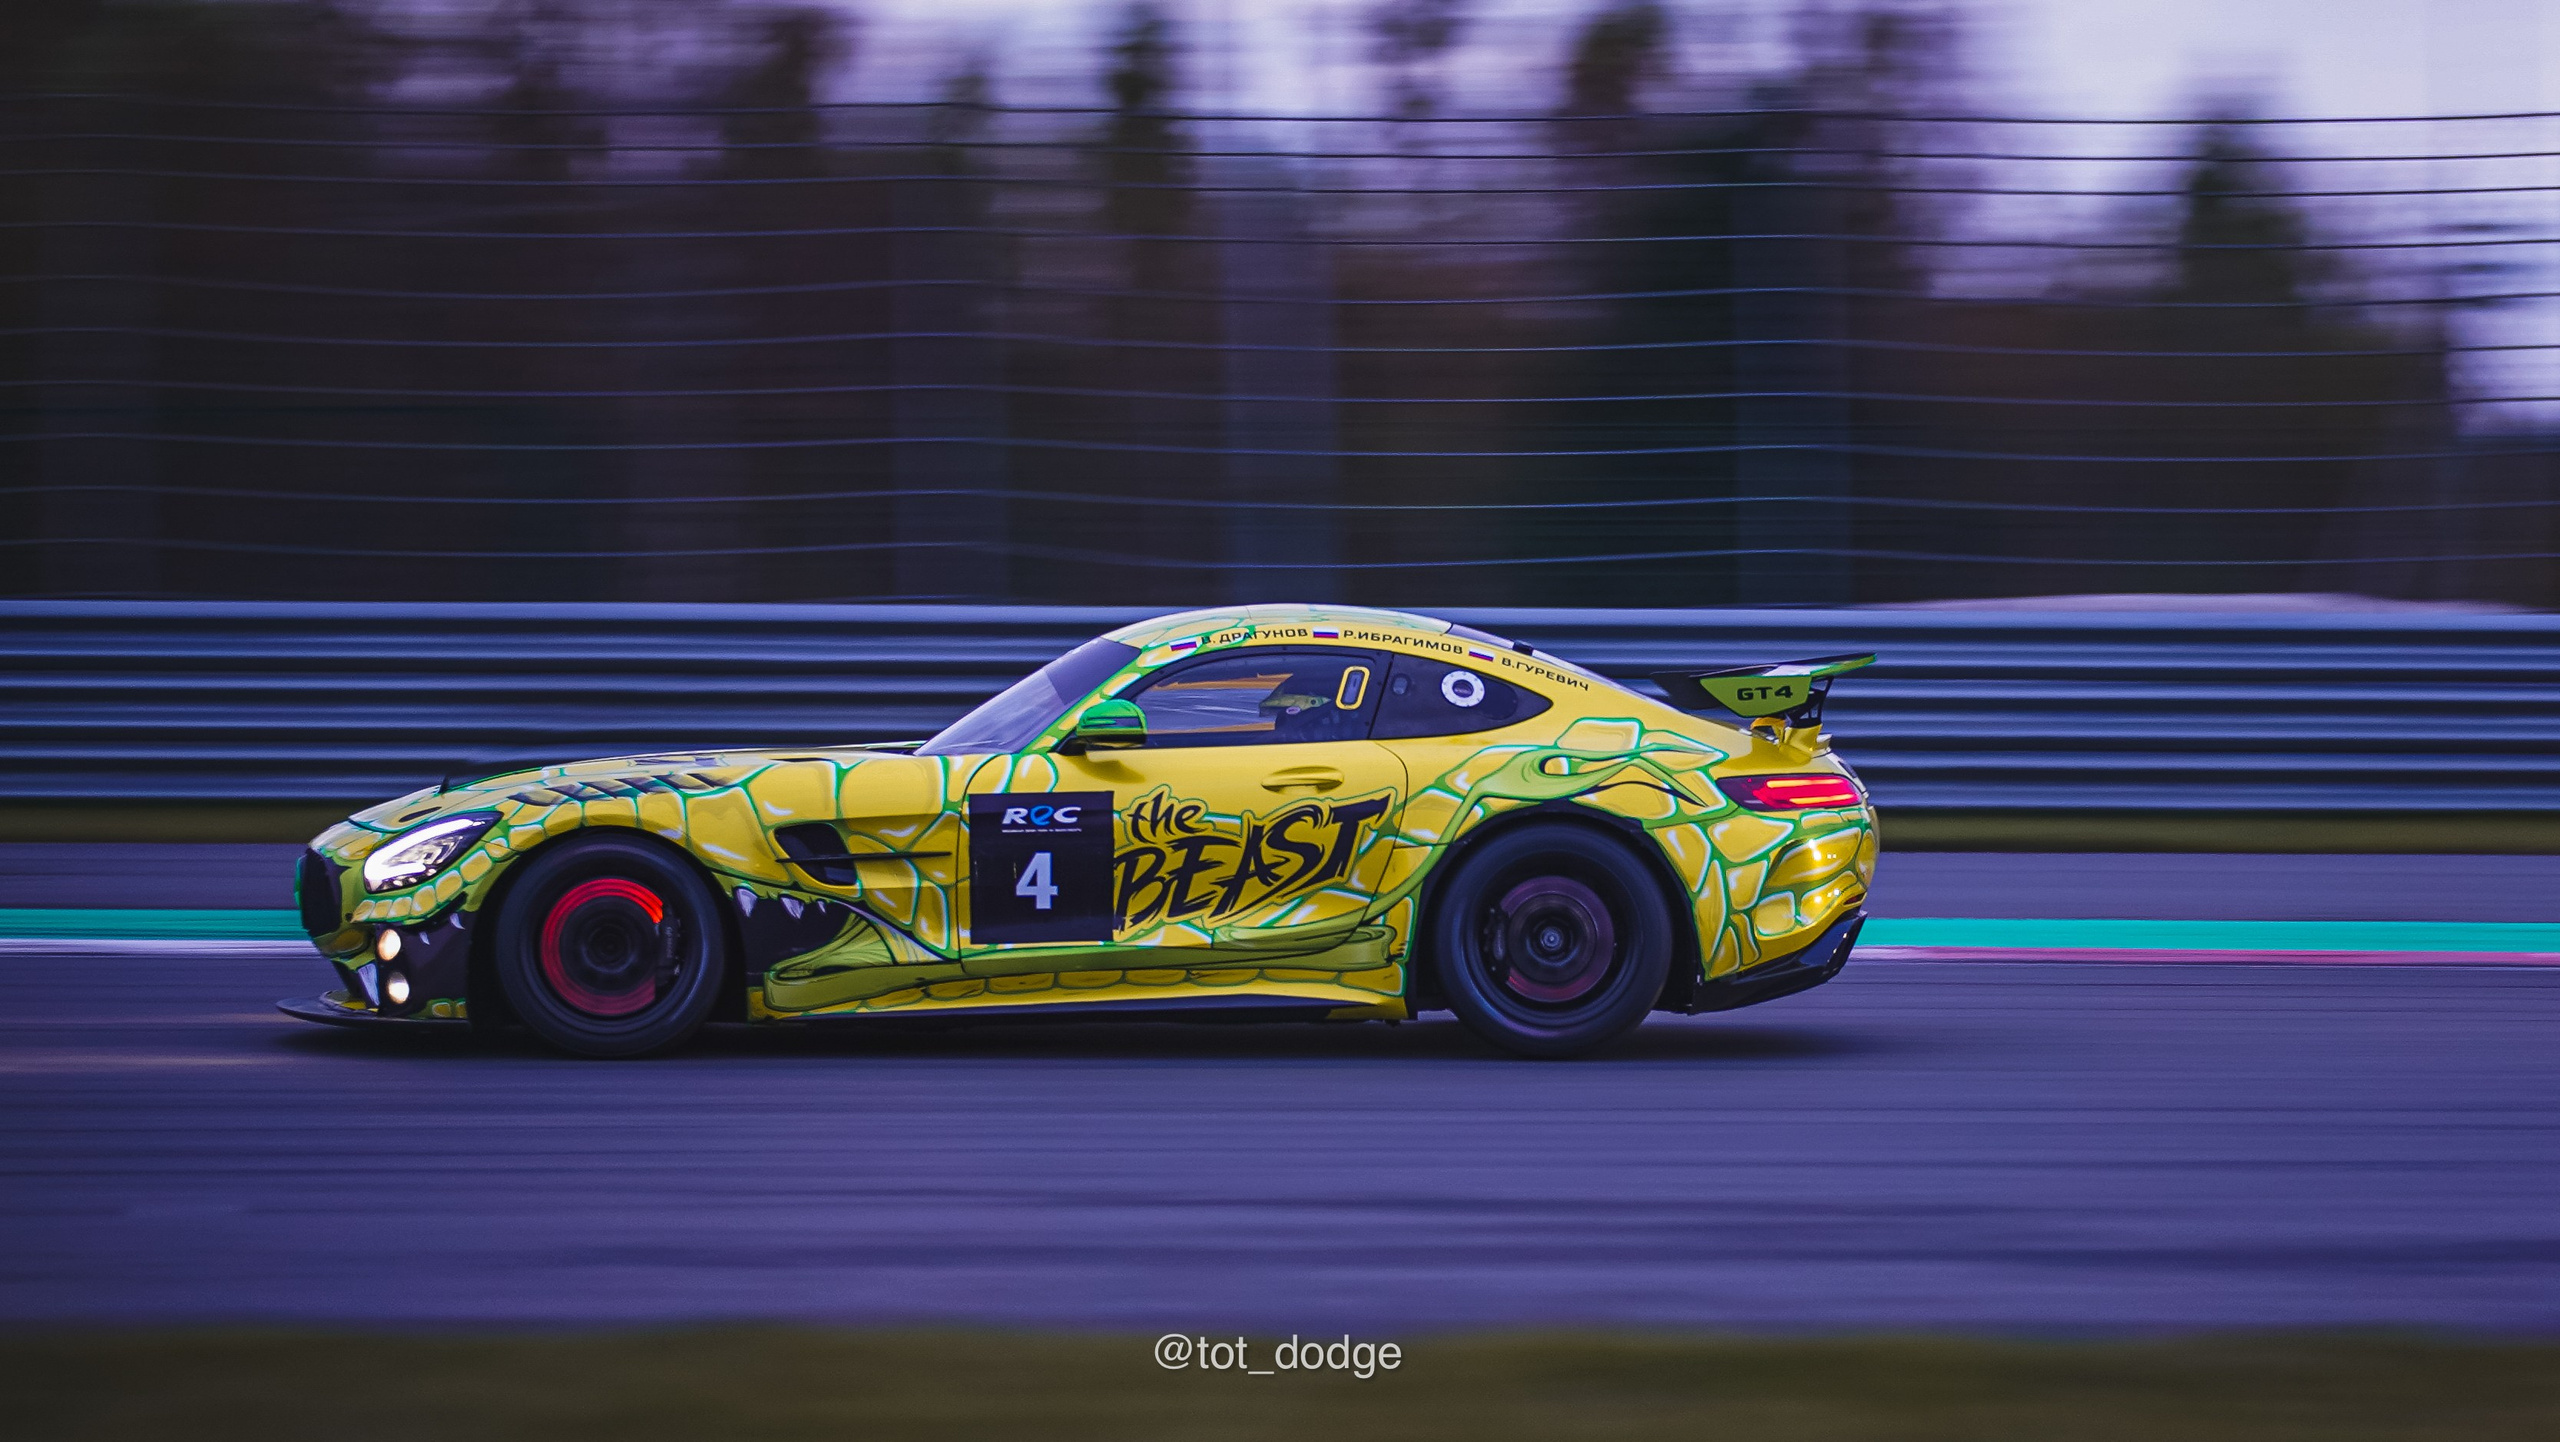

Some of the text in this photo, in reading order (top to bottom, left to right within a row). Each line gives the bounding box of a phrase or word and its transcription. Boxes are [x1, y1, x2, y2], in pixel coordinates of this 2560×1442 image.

[1219, 628, 1308, 643] ДРАГУНОВ
[1343, 629, 1463, 655] Р.ИБРАГИМОВ
[1501, 656, 1589, 691] В.ГУРЕВИЧ
[1737, 685, 1793, 701] GT4
[1128, 791, 1208, 845] the
[1016, 852, 1059, 910] 4
[1113, 793, 1391, 935] BEAST
